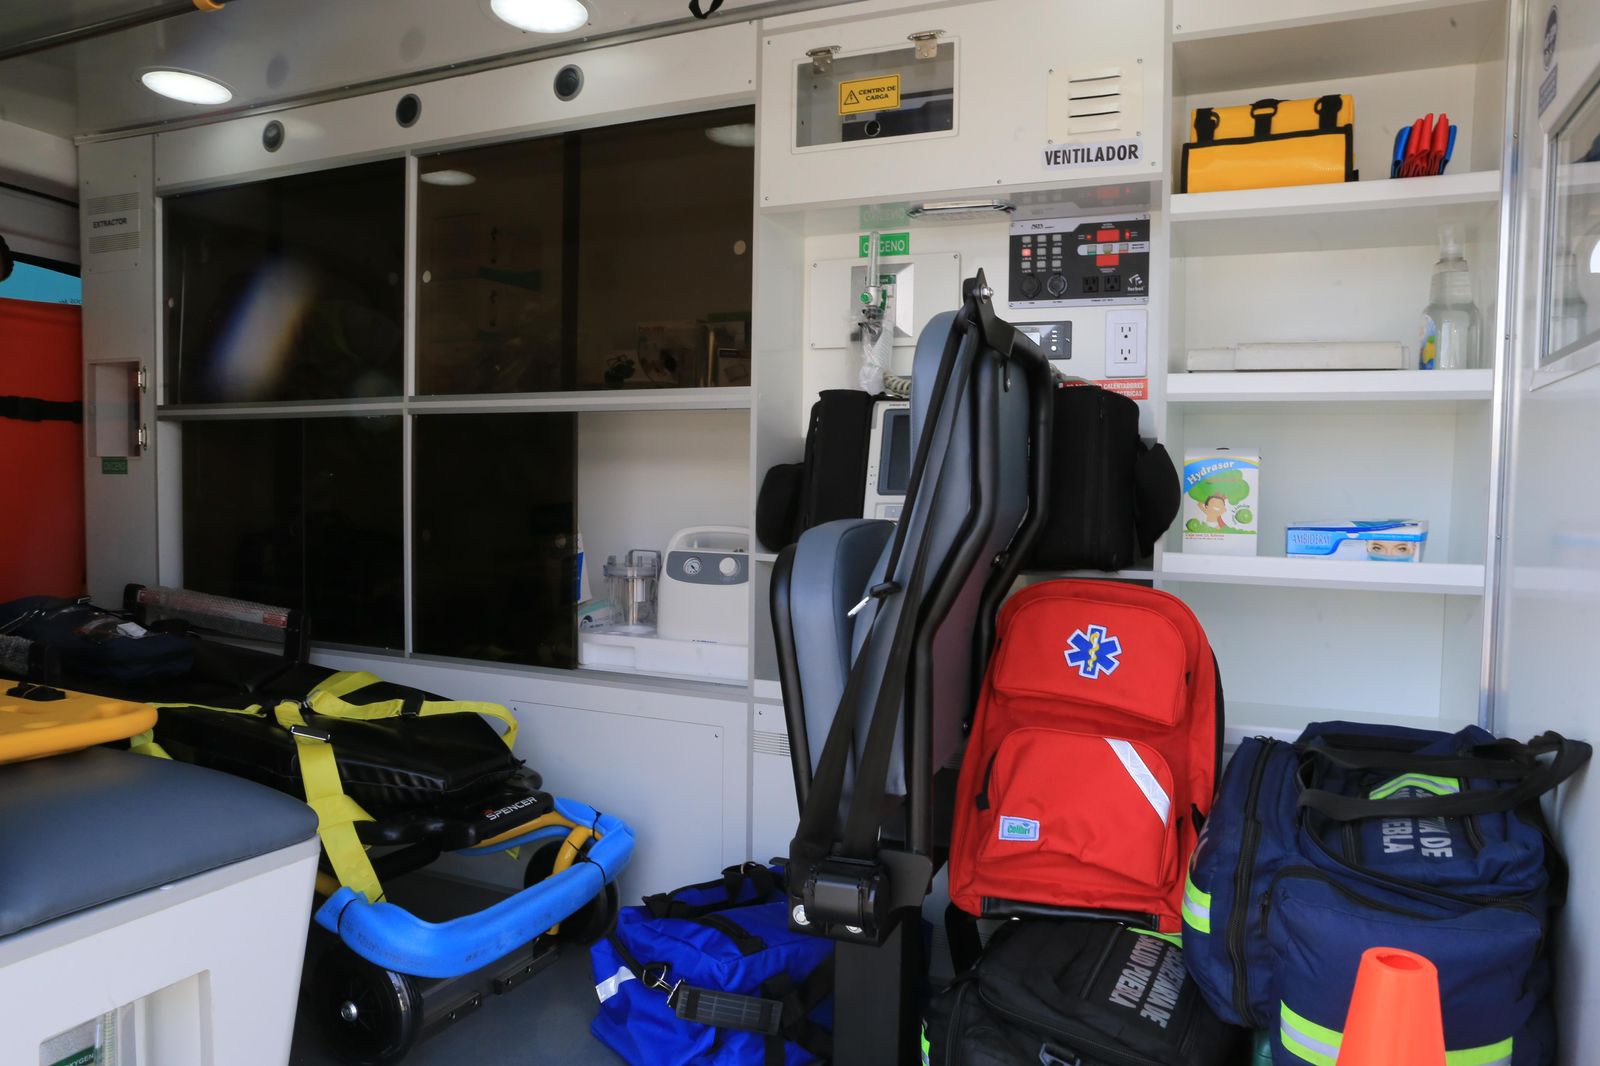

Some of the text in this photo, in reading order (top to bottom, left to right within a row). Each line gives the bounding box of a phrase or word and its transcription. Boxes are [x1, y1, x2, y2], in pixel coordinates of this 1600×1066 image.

[859, 87, 885, 95] CENTRO
[866, 93, 889, 101] CARGA
[1045, 144, 1139, 165] VENTILADOR
[92, 217, 127, 229] EXTRACTOR
[486, 796, 537, 820] SPENCER
[1420, 837, 1453, 857] DE
[1109, 961, 1152, 1009] PUEBLA
[1140, 1002, 1172, 1029] DE
